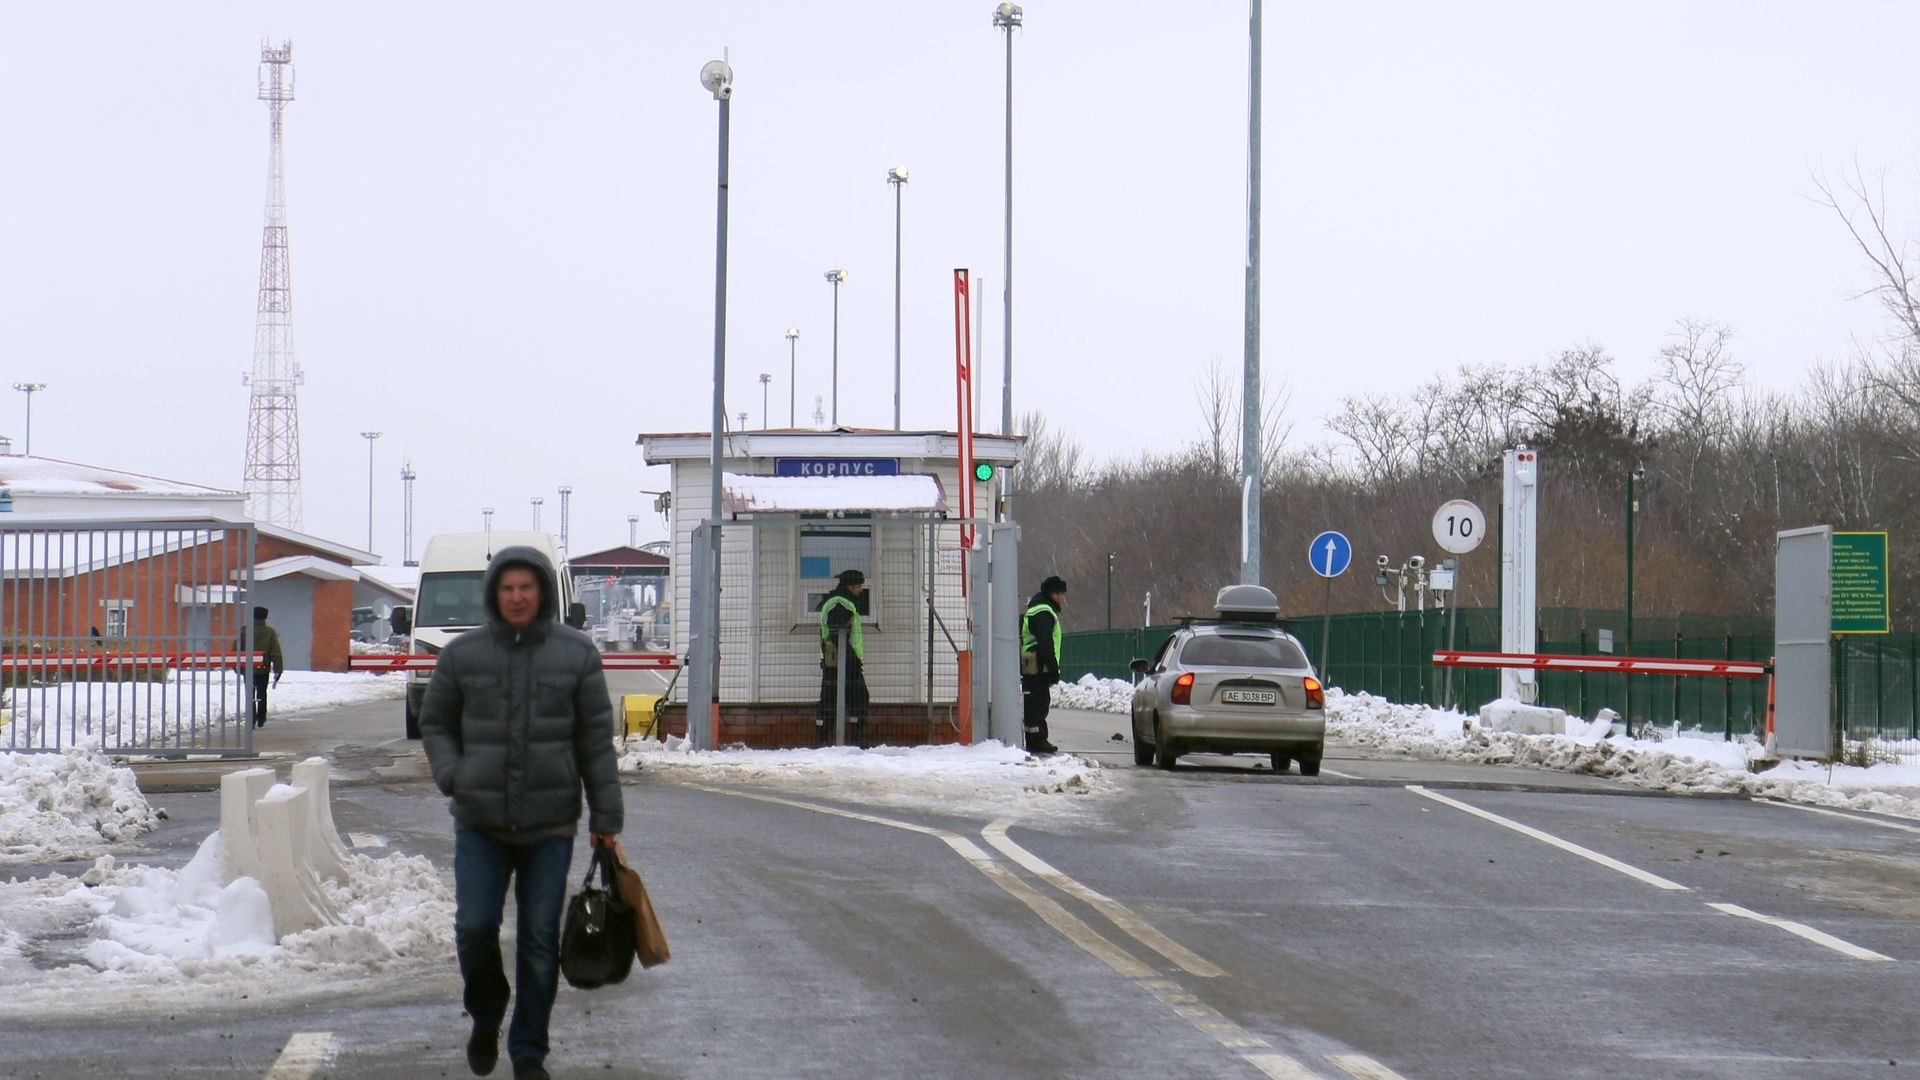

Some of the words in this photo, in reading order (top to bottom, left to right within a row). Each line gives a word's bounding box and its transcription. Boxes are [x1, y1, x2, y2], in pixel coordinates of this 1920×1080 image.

[801, 463, 874, 475] КОРПУС
[1447, 515, 1473, 537] 10
[1228, 692, 1239, 701] AE
[1241, 693, 1260, 702] 3038
[1261, 693, 1273, 702] BP
